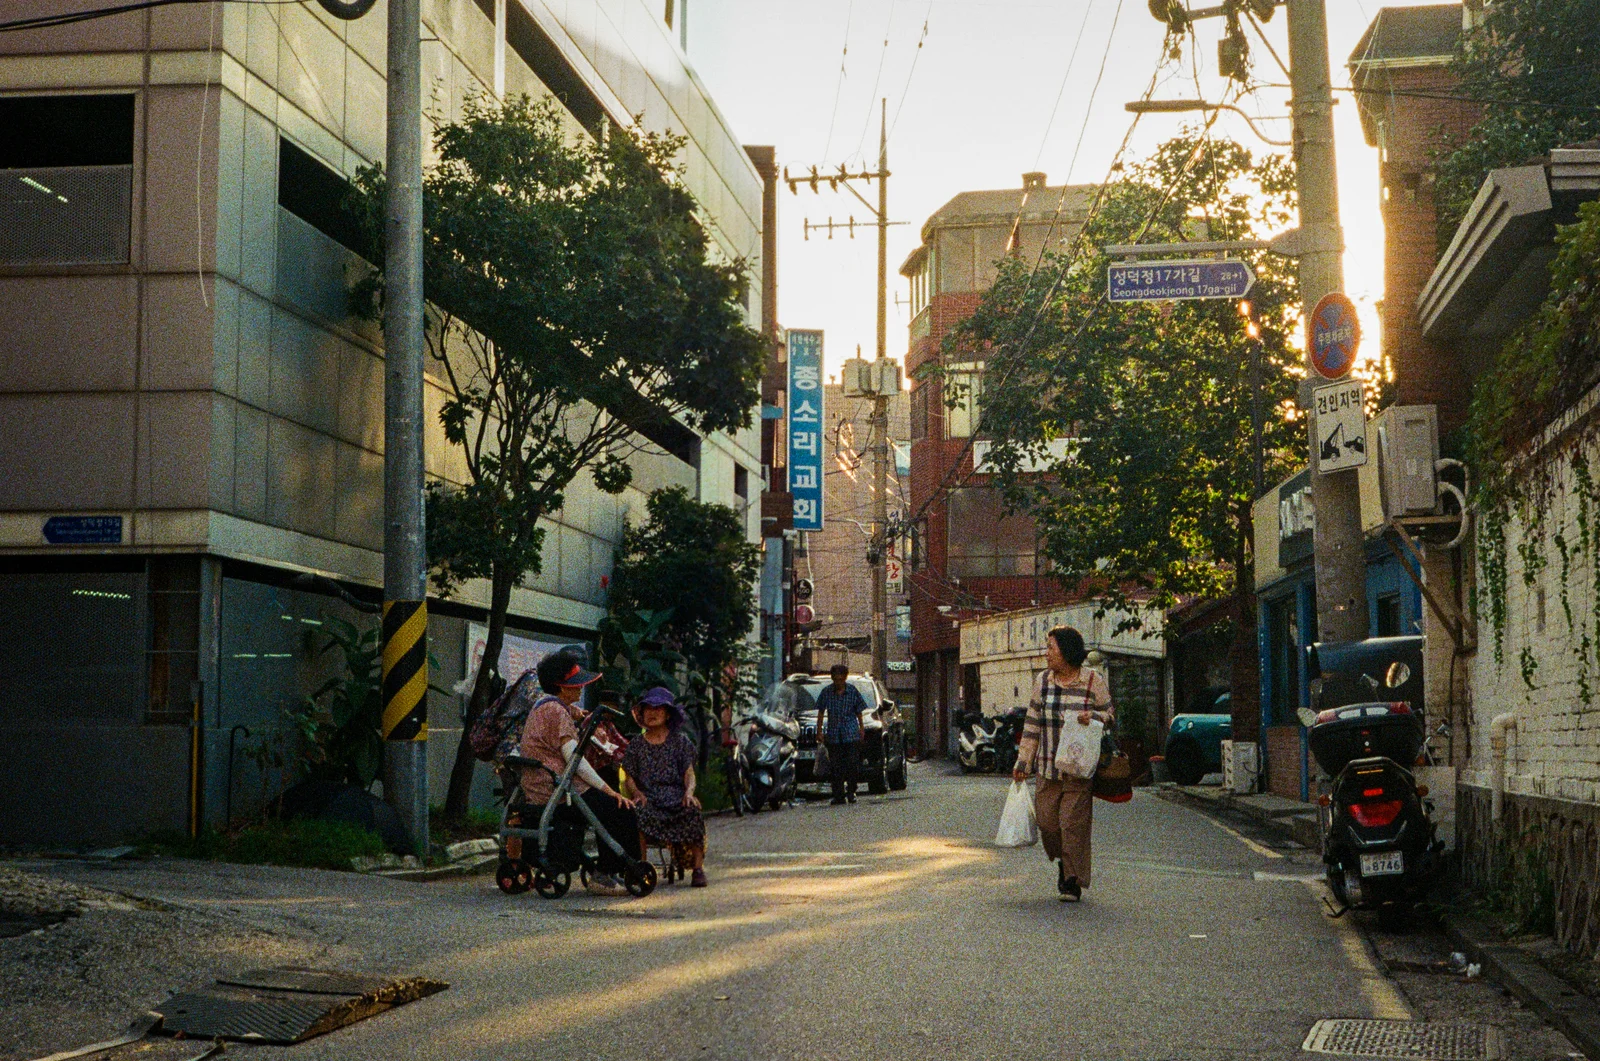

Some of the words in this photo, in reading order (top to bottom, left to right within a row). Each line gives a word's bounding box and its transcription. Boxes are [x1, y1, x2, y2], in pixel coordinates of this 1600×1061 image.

[1113, 267, 1200, 286] 성덕정17가길
[1113, 286, 1194, 298] Seongdeokjeong
[1198, 284, 1237, 295] 17ga-gil
[1318, 388, 1360, 415] 견인지역
[1372, 860, 1401, 872] 8746
